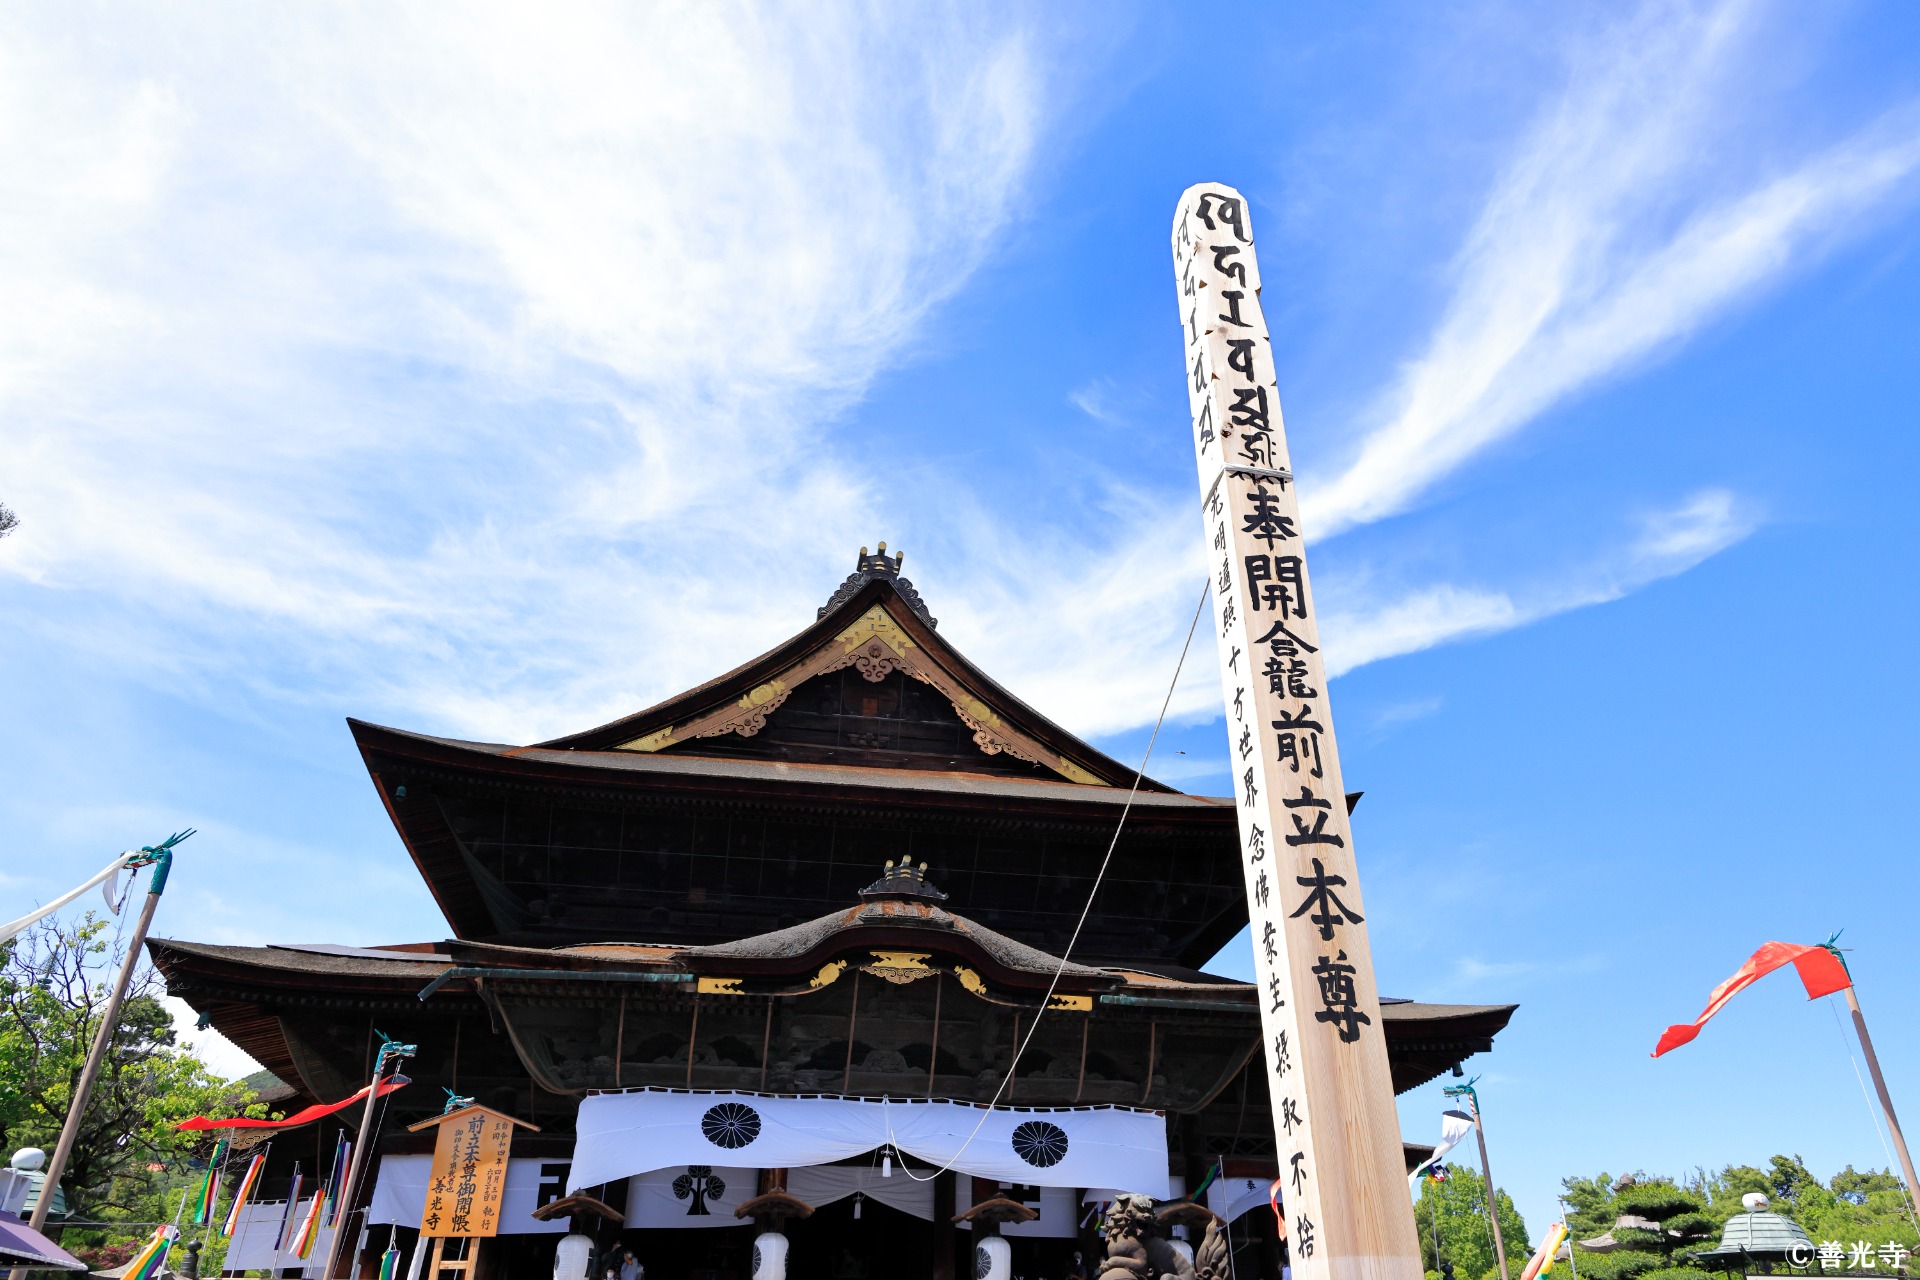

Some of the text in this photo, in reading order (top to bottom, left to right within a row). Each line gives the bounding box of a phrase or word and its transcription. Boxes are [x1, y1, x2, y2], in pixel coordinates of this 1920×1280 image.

[425, 1176, 447, 1231] 善光寺
[451, 1114, 486, 1233] 前立本尊御開帳
